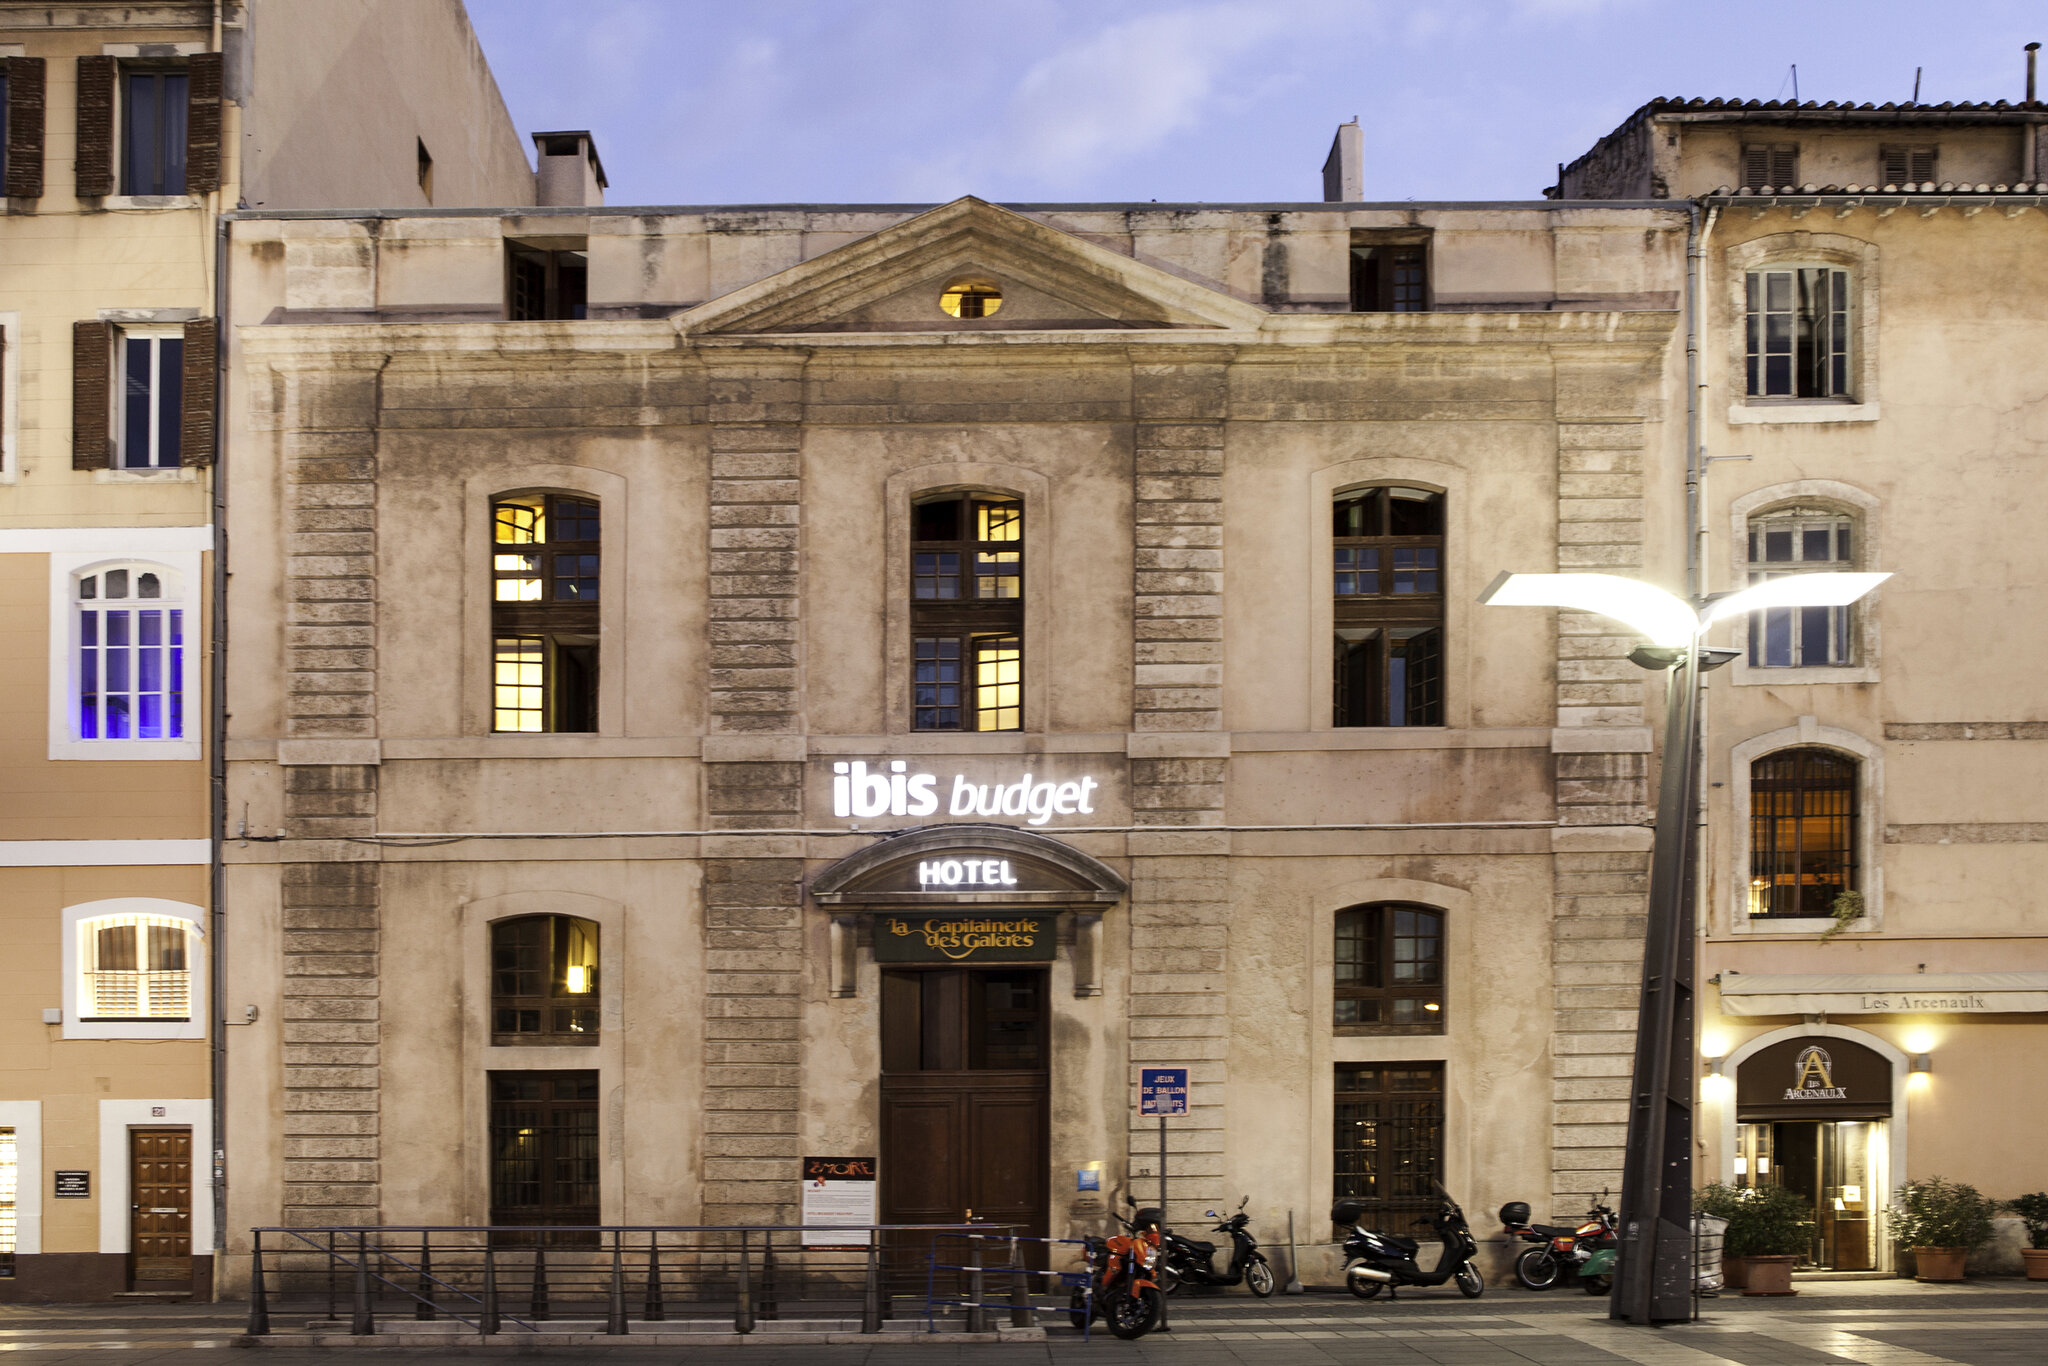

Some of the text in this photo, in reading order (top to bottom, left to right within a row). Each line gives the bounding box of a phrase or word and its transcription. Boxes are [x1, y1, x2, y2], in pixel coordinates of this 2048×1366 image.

[833, 760, 1098, 826] ibis budget
[919, 859, 1017, 886] HOTEL
[924, 918, 1039, 936] Capitainerie
[926, 933, 1034, 948] des Galères
[1861, 995, 1984, 1009] Les Arcenaulx
[1154, 1075, 1175, 1083] JEUX
[1783, 1087, 1847, 1100] ARCENAULX
